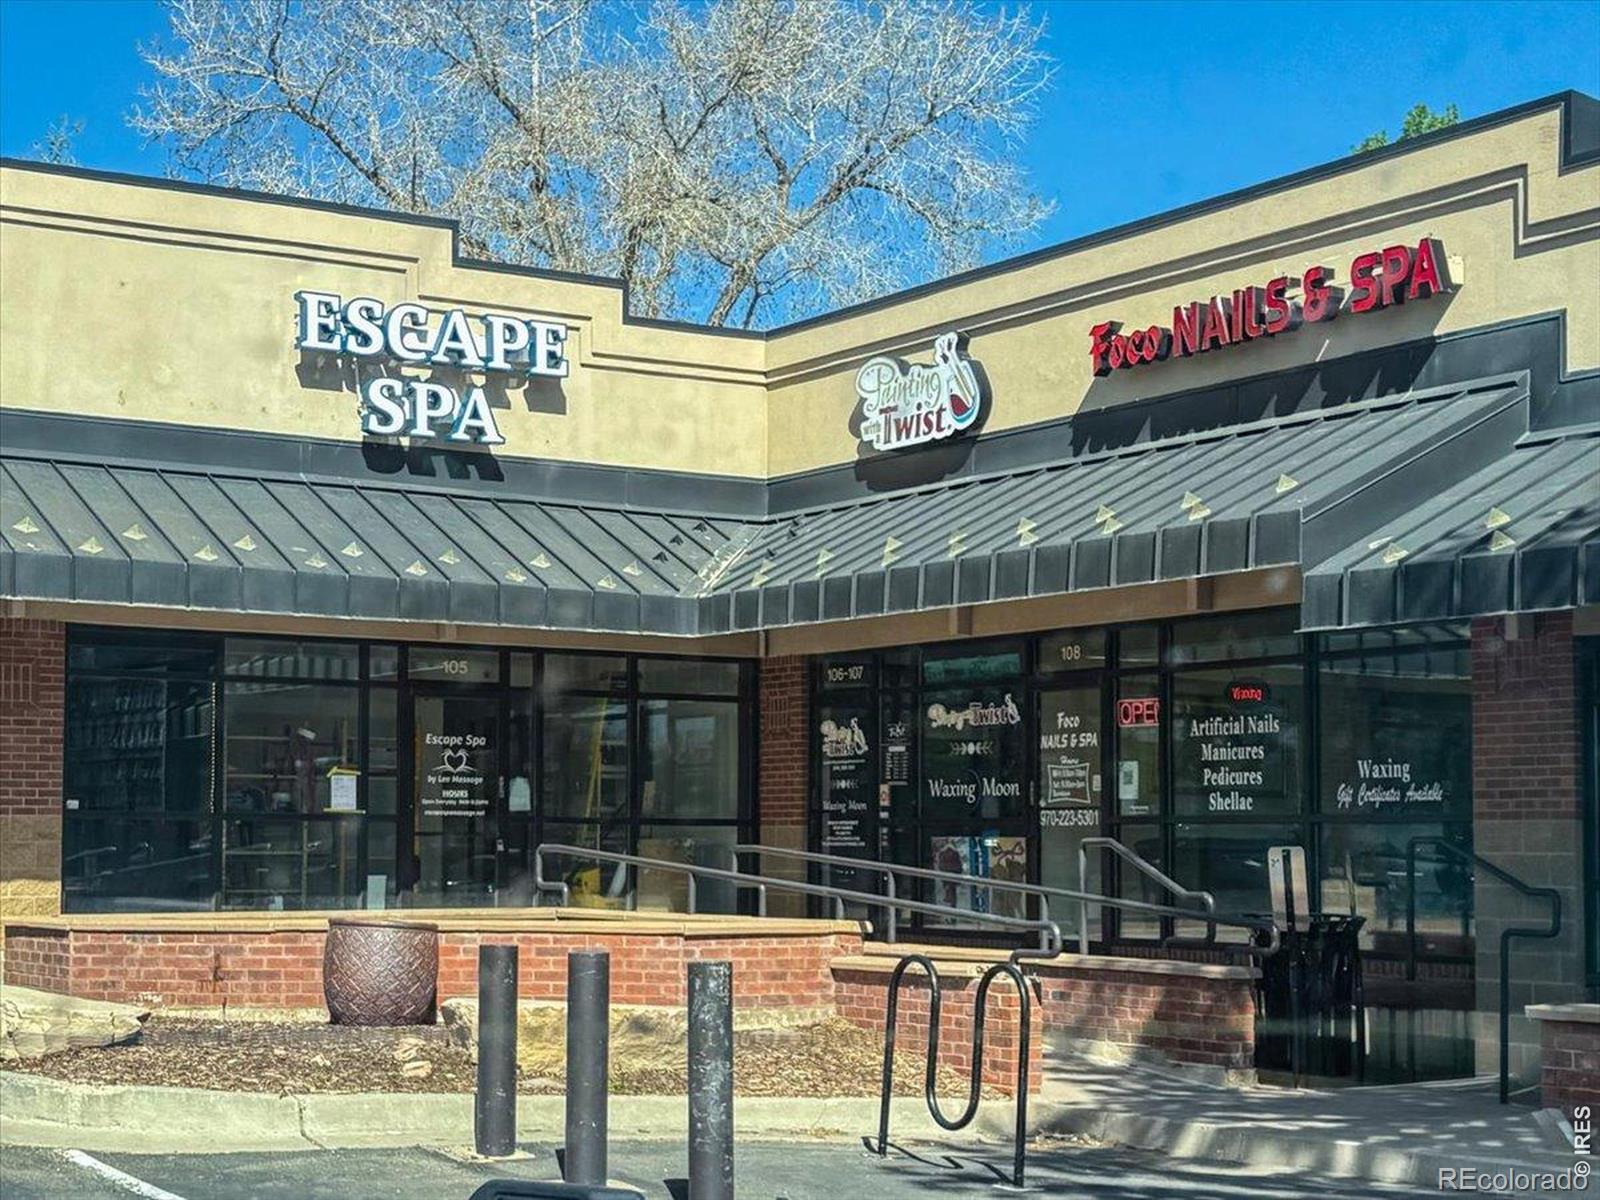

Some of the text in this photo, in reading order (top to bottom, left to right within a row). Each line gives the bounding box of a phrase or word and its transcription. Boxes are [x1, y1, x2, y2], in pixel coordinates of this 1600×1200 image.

[1090, 237, 1441, 377] Foco NAILS & SPA
[295, 291, 569, 378] ESCAPE
[858, 361, 942, 411] Painting
[360, 377, 506, 444] SPA
[879, 402, 947, 445] Twist
[1062, 645, 1081, 660] 108
[442, 660, 468, 675] 105
[827, 666, 864, 681] 106-107
[1057, 711, 1080, 729] Foco
[1190, 714, 1280, 737] Artificial Nails
[425, 733, 486, 748] Escape Spa
[1040, 732, 1098, 749] NAILS & SPA
[1201, 742, 1265, 761] Manicures
[1203, 767, 1263, 786] Pedicures
[1357, 758, 1410, 782] Waxing
[928, 778, 1020, 803] Waxing Moon
[1209, 791, 1253, 811] Shellac
[1040, 809, 1099, 826] 970-223-5301
